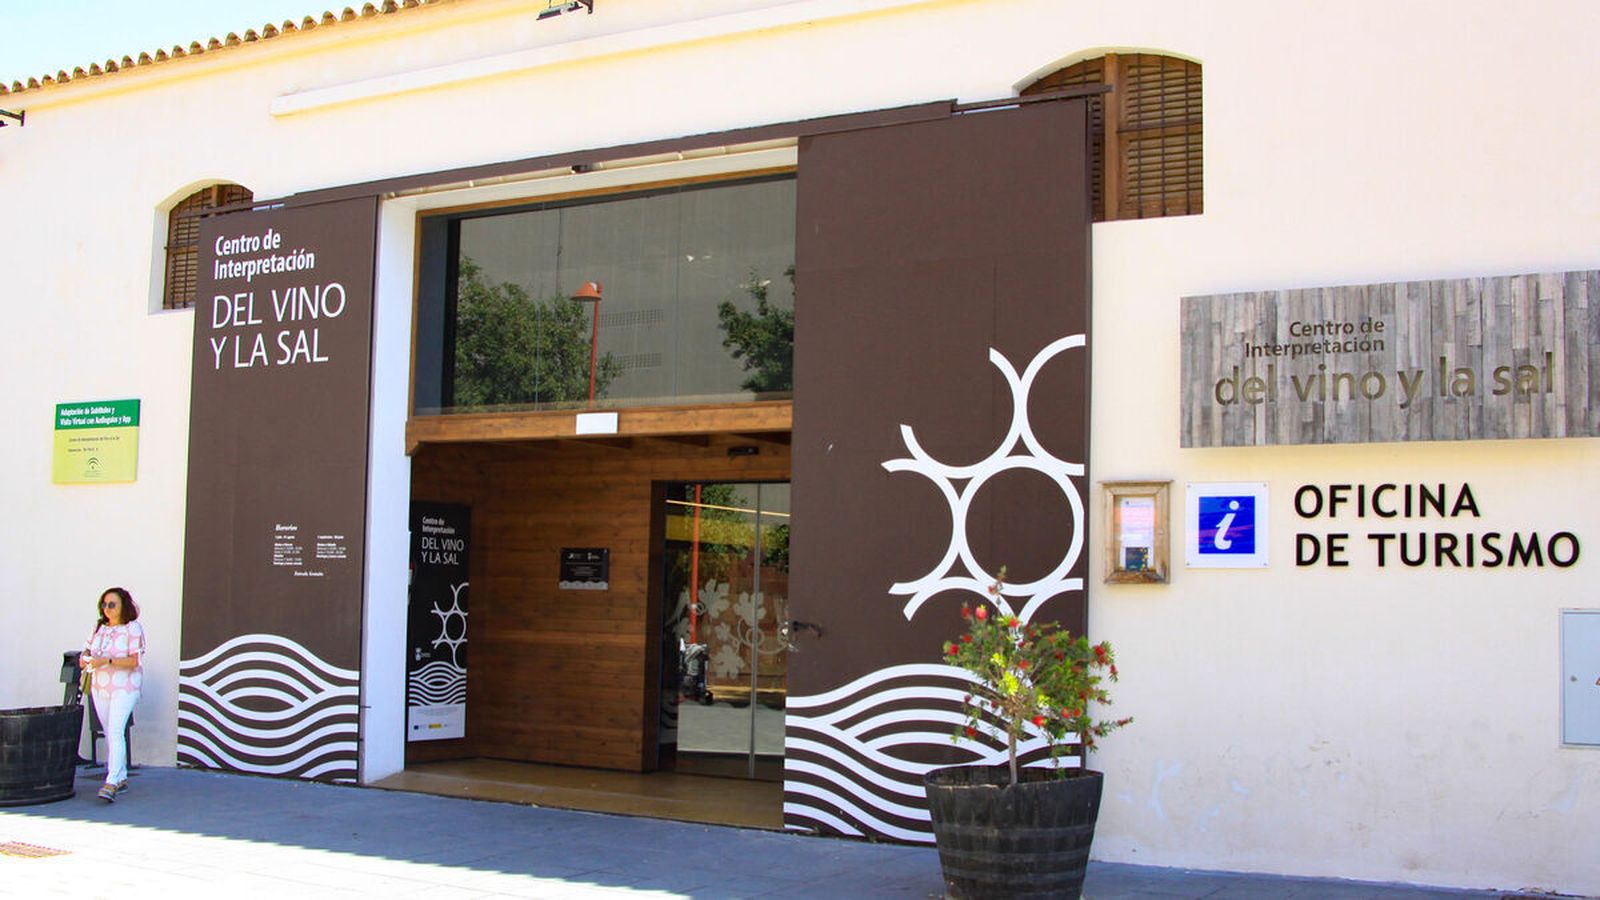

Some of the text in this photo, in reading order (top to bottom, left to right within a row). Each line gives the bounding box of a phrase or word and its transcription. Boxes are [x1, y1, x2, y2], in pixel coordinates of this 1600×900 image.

[215, 228, 281, 257] Centro de
[214, 248, 315, 282] Interpretación
[212, 282, 346, 329] DEL VINO
[1289, 317, 1385, 338] Centro de
[210, 328, 329, 370] Y LA SAL
[1245, 336, 1385, 360] Interpretación
[1214, 351, 1553, 409] del vino y la sal
[1294, 482, 1481, 518] OFICINA
[422, 516, 445, 526] Centro de
[421, 536, 464, 551] DEL VINO
[421, 551, 459, 565] Y LA SAL
[1295, 531, 1580, 568] DE TURISMO
